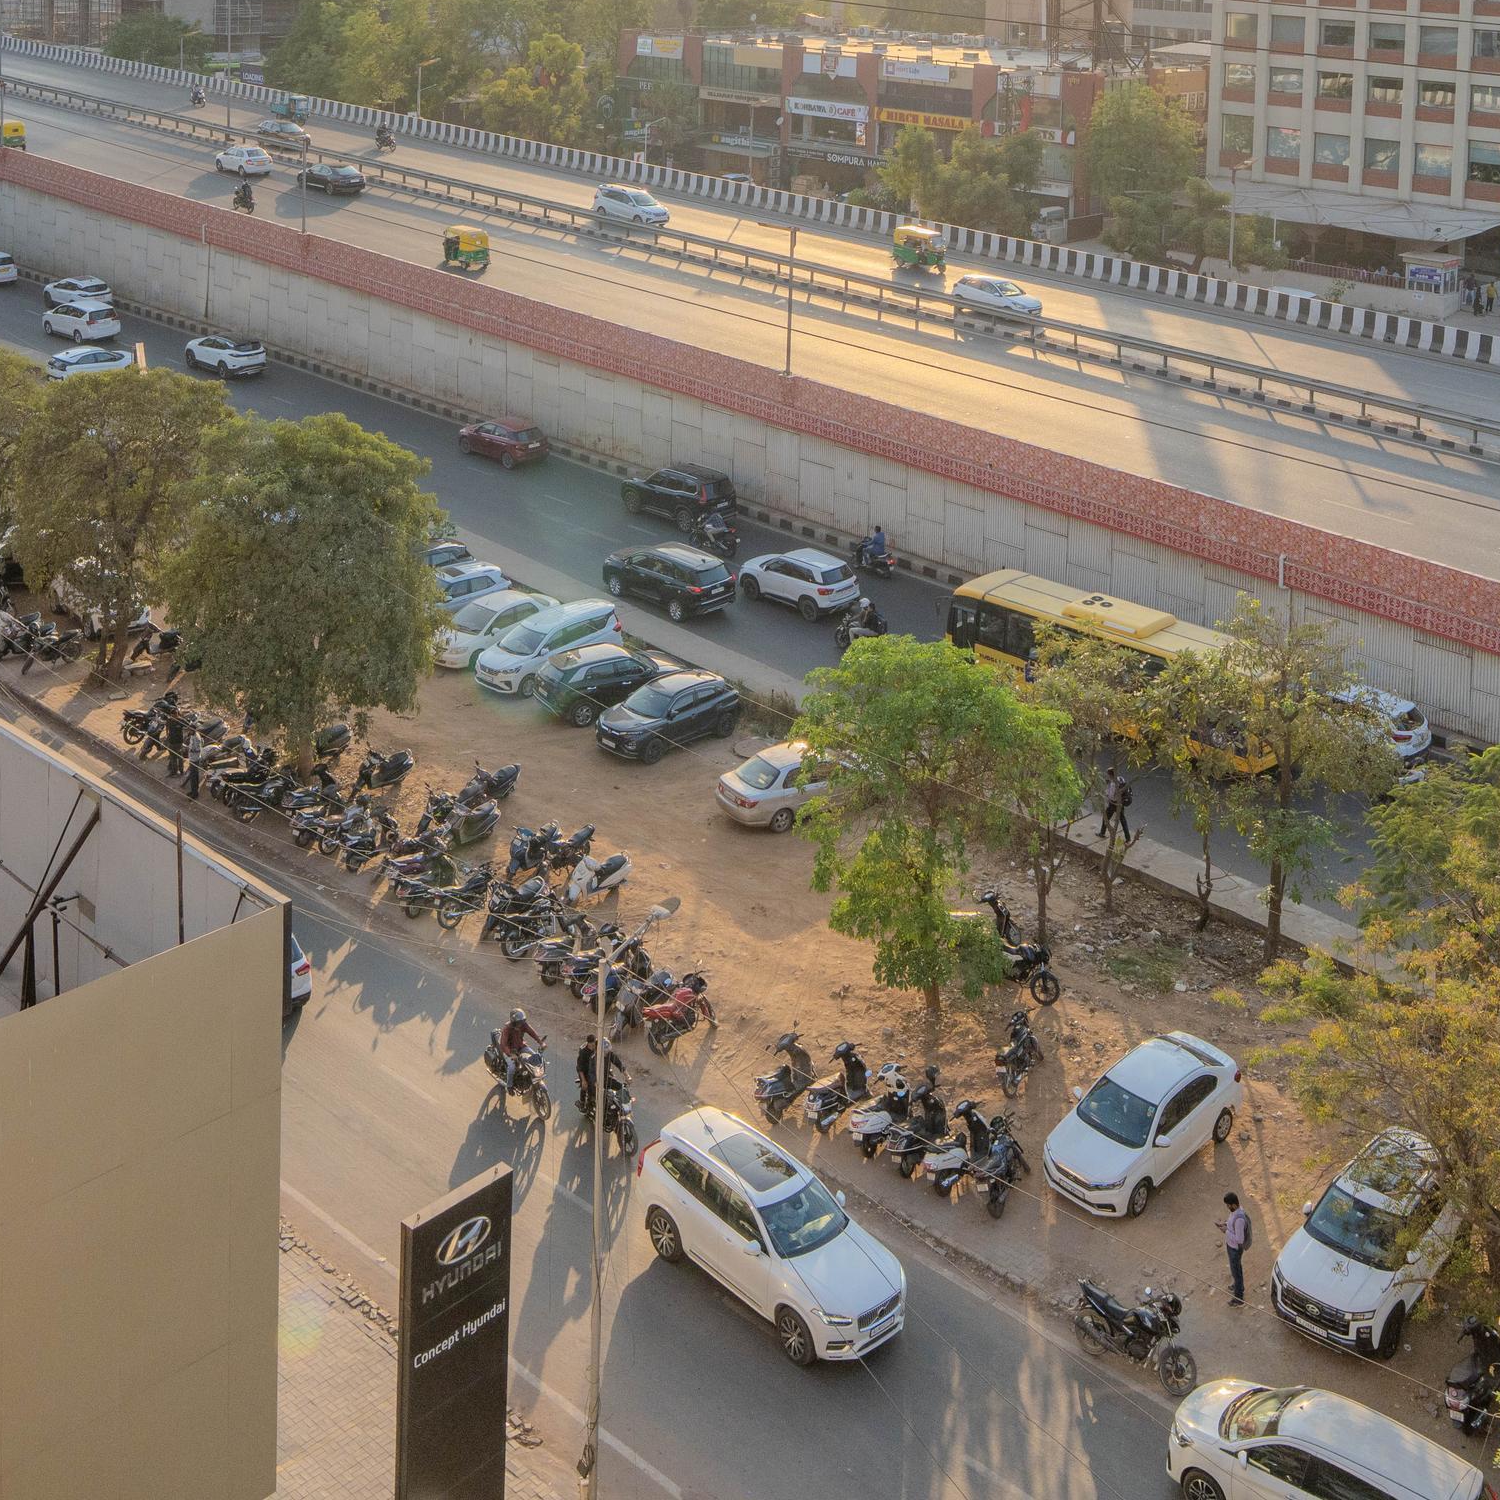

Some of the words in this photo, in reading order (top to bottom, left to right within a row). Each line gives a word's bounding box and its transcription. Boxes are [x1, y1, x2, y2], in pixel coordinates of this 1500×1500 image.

[826, 153, 865, 167] SOMPURA
[422, 1241, 502, 1304] HYUNDAI
[413, 1329, 460, 1369] Concept
[462, 1298, 506, 1338] Hyundai
